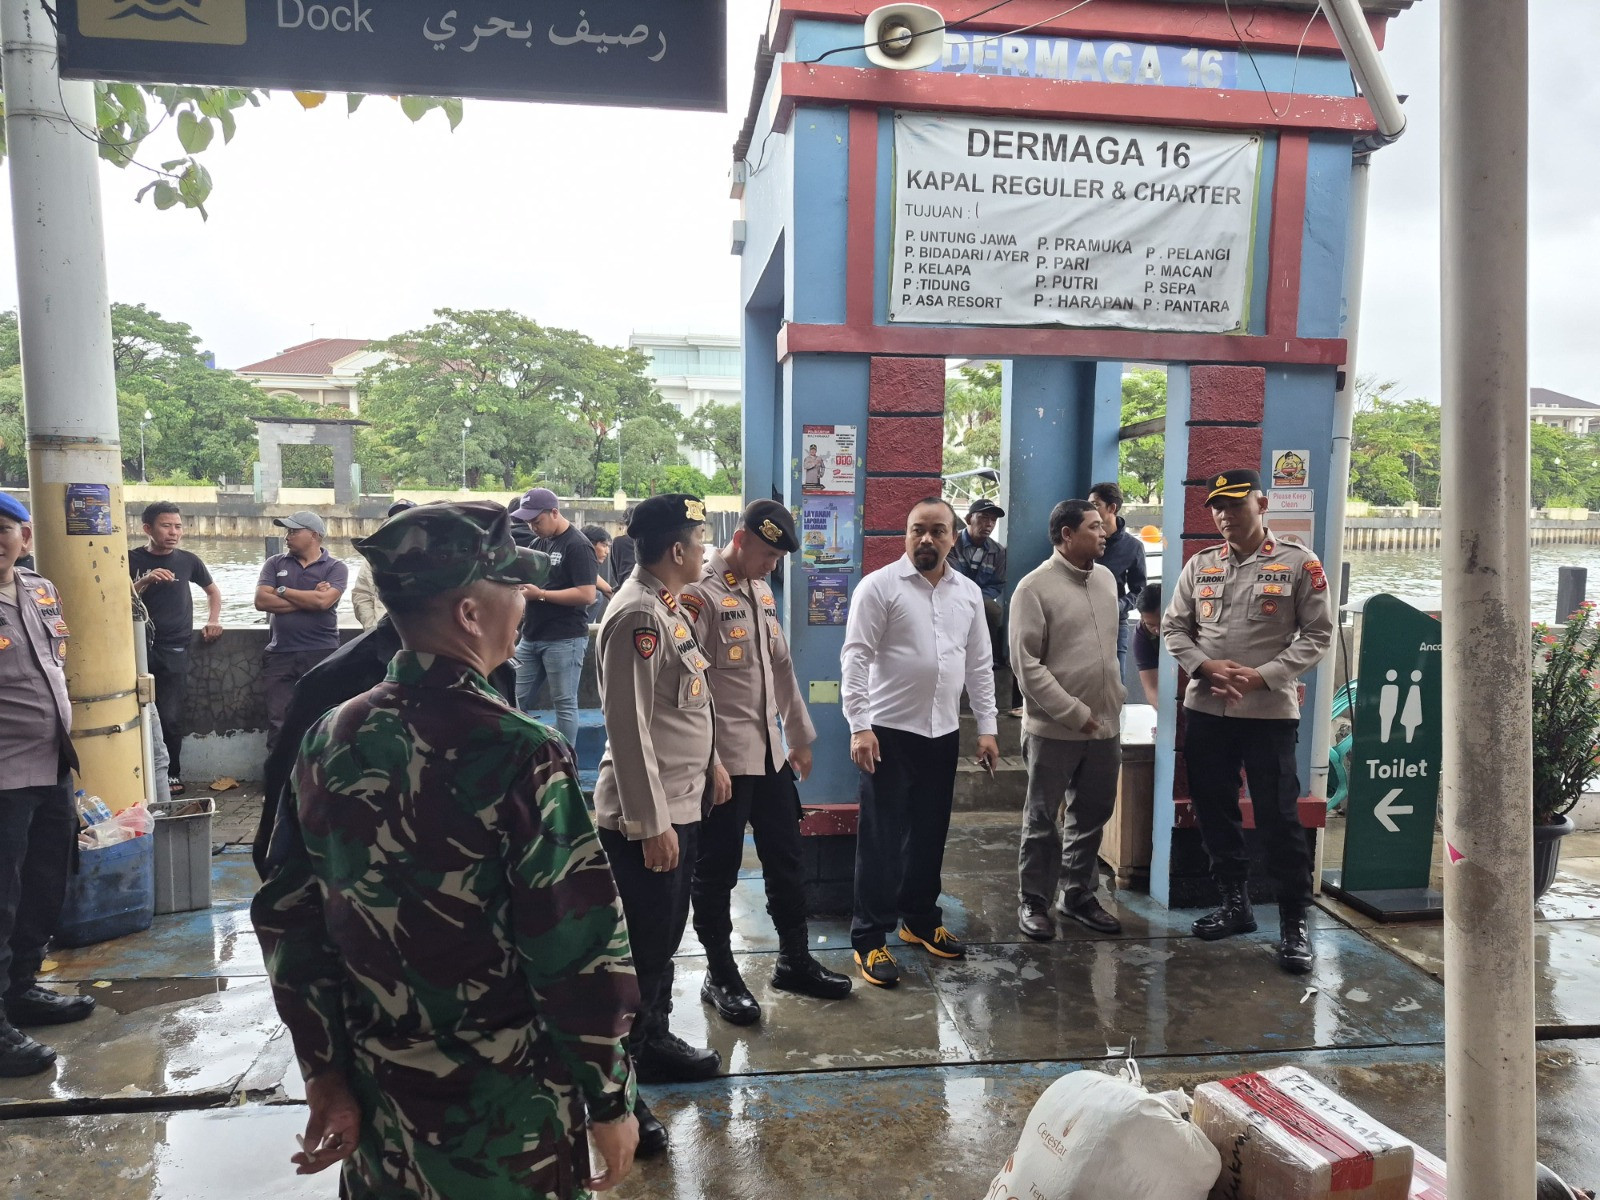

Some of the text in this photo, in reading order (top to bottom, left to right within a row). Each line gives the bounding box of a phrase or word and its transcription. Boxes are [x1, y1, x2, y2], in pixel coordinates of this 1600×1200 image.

[276, 0, 374, 33] Dock
[422, 9, 667, 62] رصيف بحري
[942, 33, 1224, 89] DERMAGA 16
[967, 125, 1192, 171] DERMAGA 16
[906, 169, 1242, 206] KAPAL REGULER & CHARTER
[904, 203, 963, 220] TUJUAN
[905, 229, 1018, 247] P. UNTUNG JAWA
[1036, 236, 1134, 255] P. PRAMUKA
[904, 245, 916, 258] P.
[919, 246, 984, 261] BIDADARI
[993, 249, 1030, 264] AYER
[1166, 247, 1231, 262] PELANGI
[904, 261, 972, 277] P. KELAPA
[1036, 255, 1091, 272] P. PARI
[1145, 263, 1213, 279] P. MACAN
[1034, 274, 1099, 291] P. PUTRI
[1143, 280, 1197, 296] P. SEPA
[901, 293, 1003, 310] P. ASA RESORT
[1056, 294, 1135, 311] HARAPAN
[1163, 298, 1230, 313] PANTARA
[1273, 492, 1307, 501] Please Keep
[1196, 575, 1225, 583] ZAROKI
[1257, 573, 1291, 582] POLRI
[721, 610, 747, 622] IRWAN
[1366, 758, 1428, 779] Toilet
[1037, 1122, 1067, 1156] Cerestar
